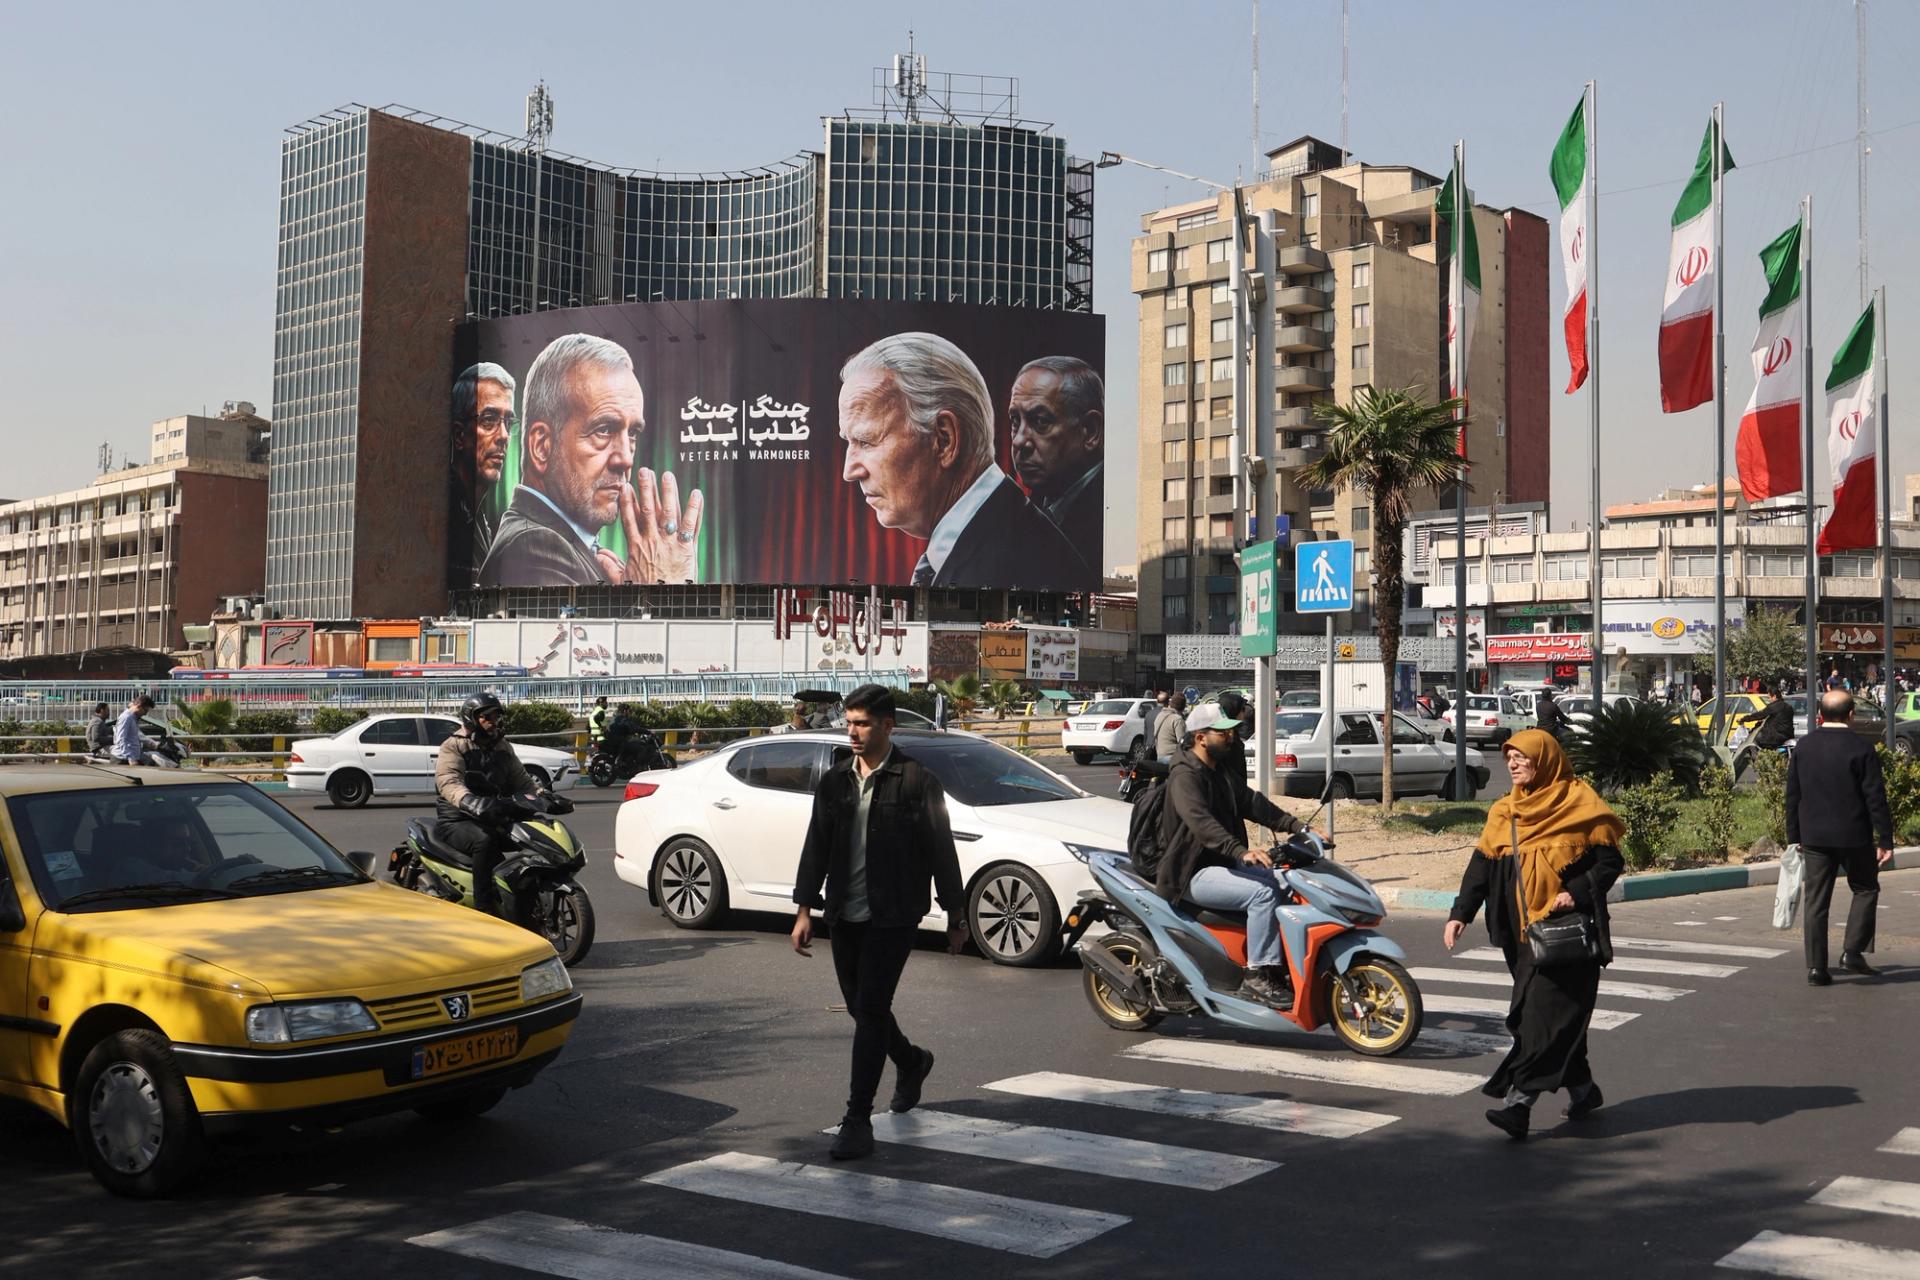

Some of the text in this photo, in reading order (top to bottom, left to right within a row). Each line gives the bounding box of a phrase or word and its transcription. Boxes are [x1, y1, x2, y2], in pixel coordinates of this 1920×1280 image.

[680, 396, 738, 424] جنگ
[749, 393, 810, 422] جنگ
[680, 421, 738, 447] بلد
[749, 420, 810, 447] طلب
[680, 449, 810, 462] VETERAN WARMONGER
[1488, 640, 1533, 649] Pharmacy
[1830, 627, 1877, 650] هدیه
